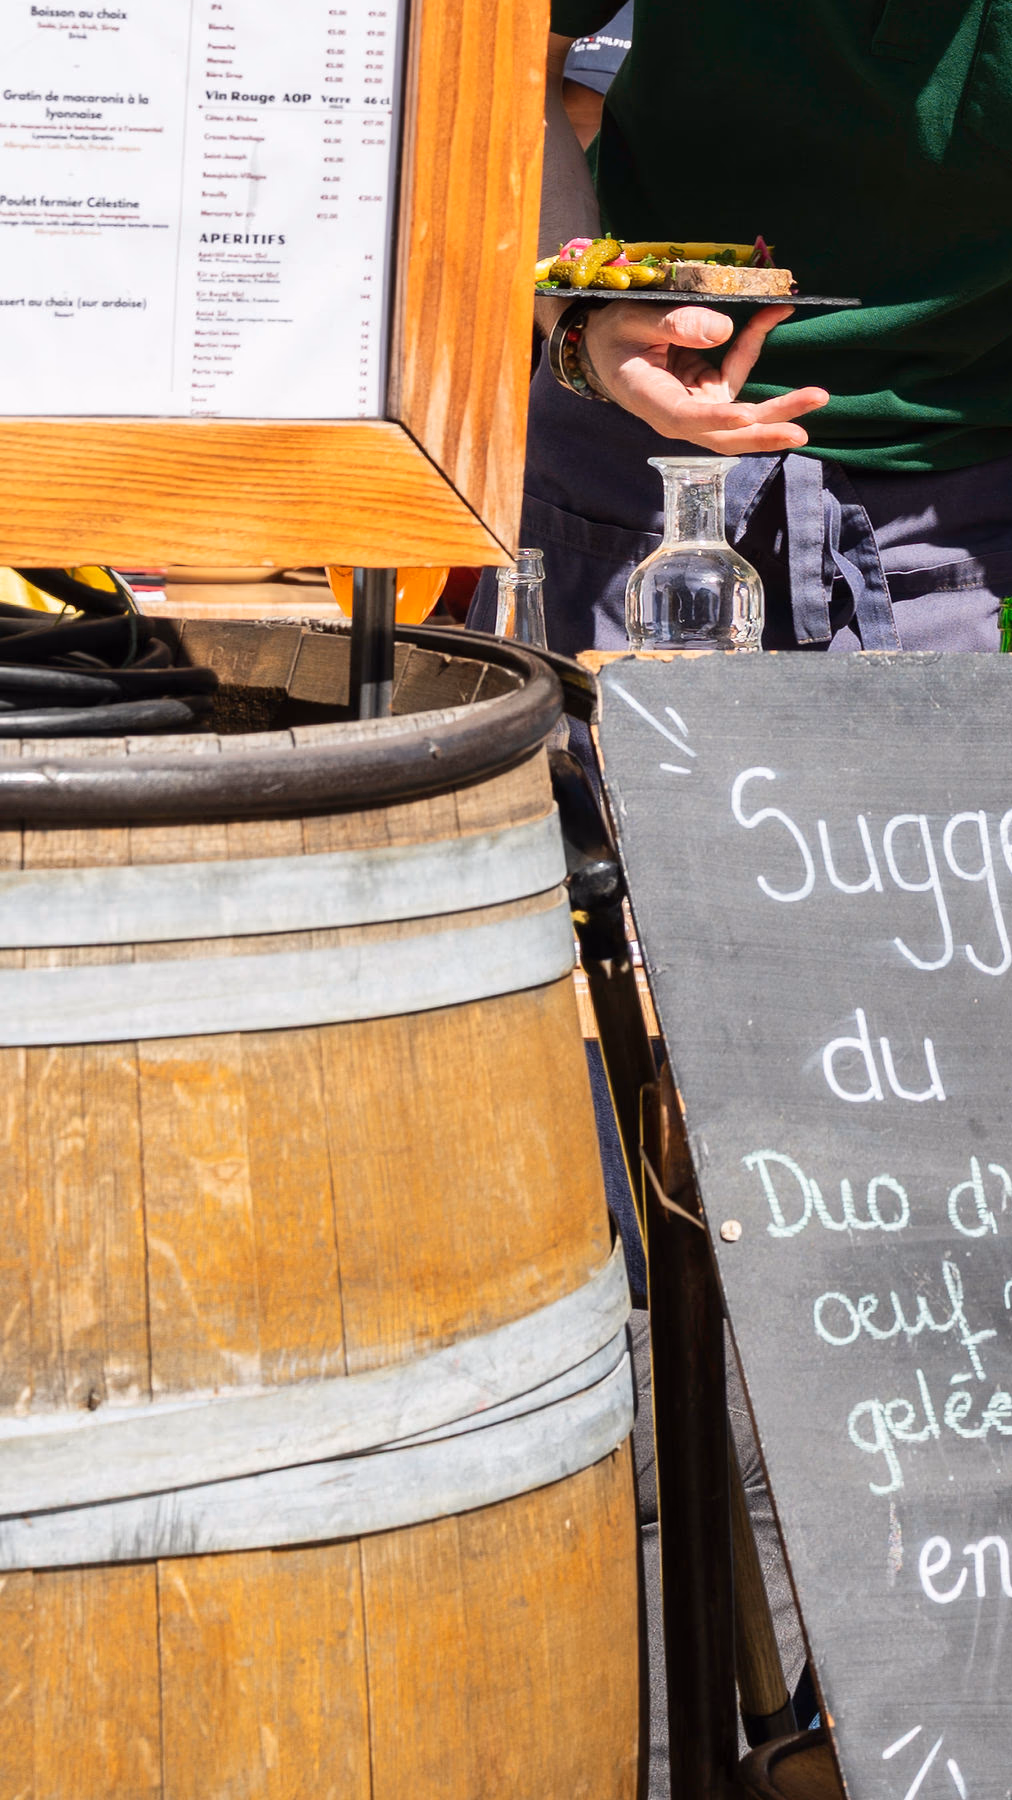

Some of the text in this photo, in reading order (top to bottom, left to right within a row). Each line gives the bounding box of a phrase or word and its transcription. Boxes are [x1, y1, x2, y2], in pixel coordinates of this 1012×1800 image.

[30, 5, 127, 20] Boisson au choix
[3, 89, 42, 101] Gratin
[45, 91, 59, 102] de
[63, 92, 124, 105] macaronis
[138, 93, 149, 105] la
[205, 90, 276, 105] Vin Rouge
[282, 94, 312, 103] AOP
[320, 95, 350, 104] Verre
[363, 97, 377, 105] 46
[46, 107, 103, 121] lyonnaise
[40, 195, 83, 208] fermier
[87, 197, 140, 209] Célestine
[199, 233, 286, 245] APERITIFS
[28, 299, 42, 307] au
[102, 298, 147, 311] ardoise)
[822, 1006, 946, 1103] du
[744, 1149, 911, 1239] Duo
[813, 1260, 998, 1380] oeuf
